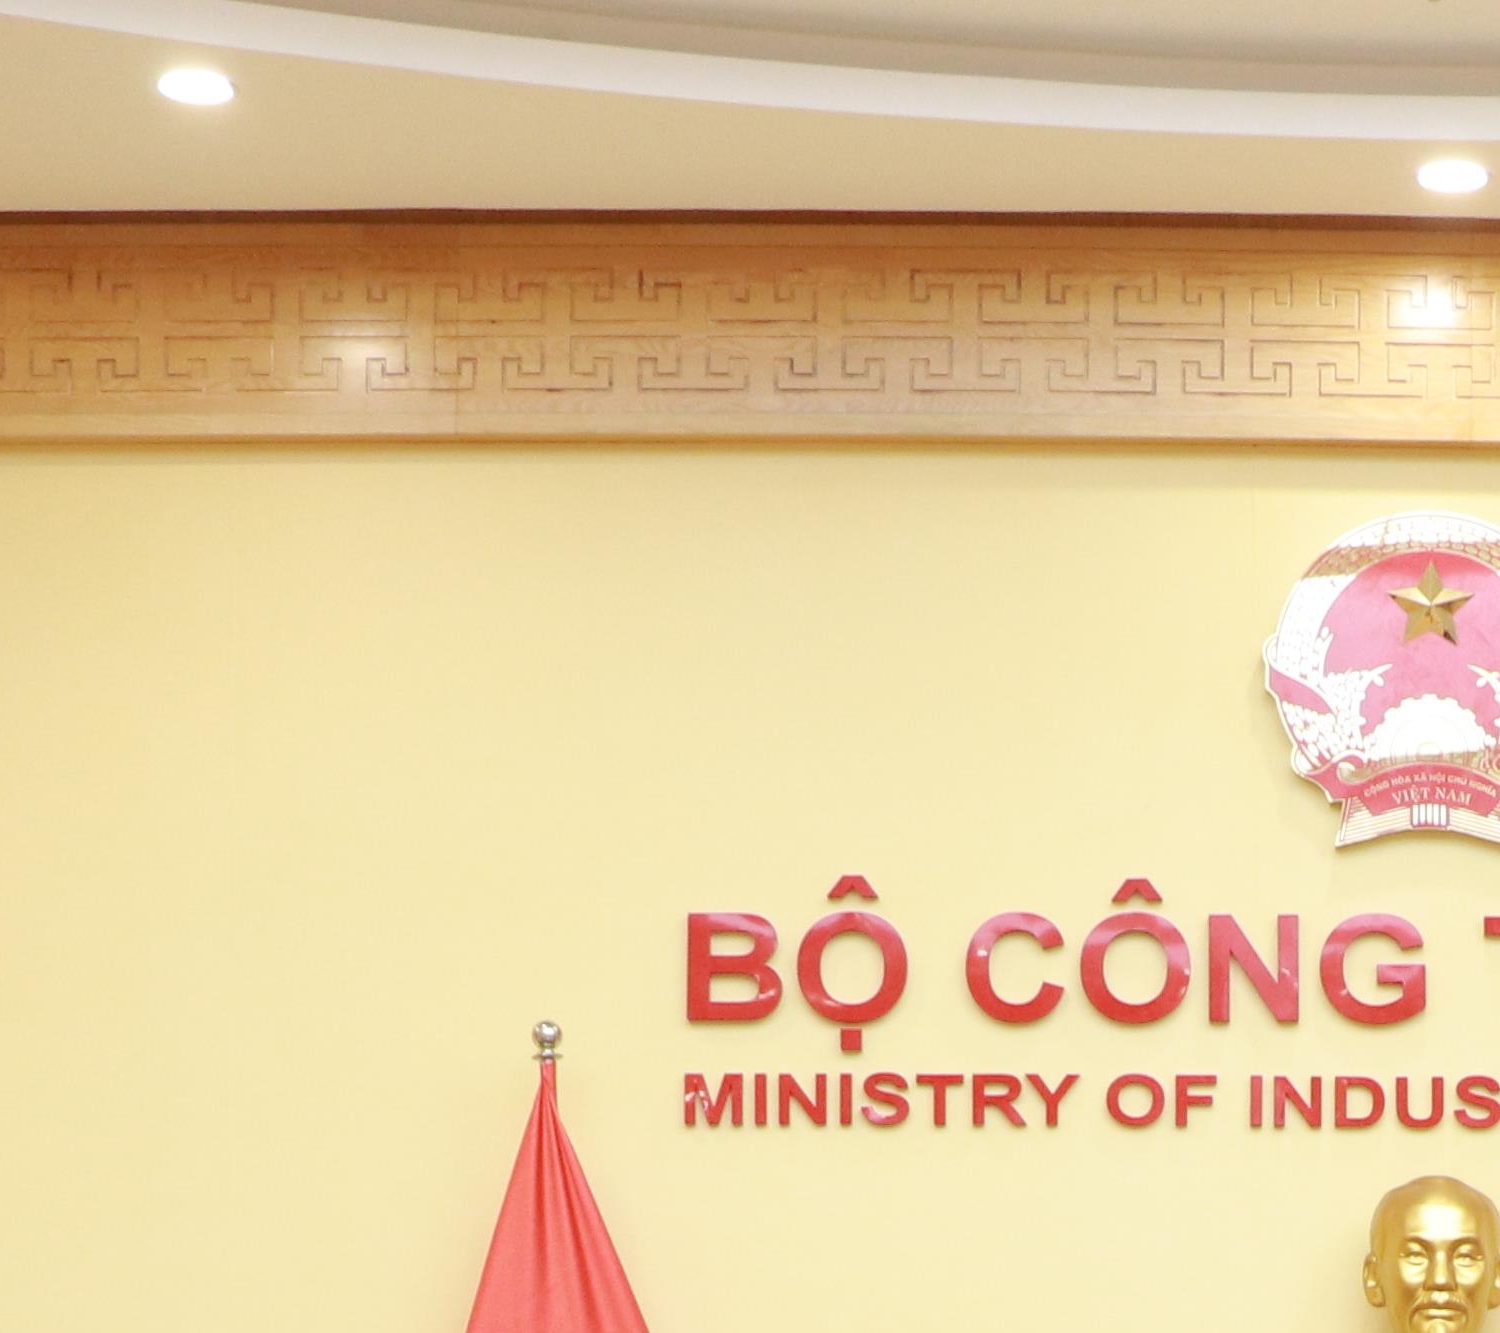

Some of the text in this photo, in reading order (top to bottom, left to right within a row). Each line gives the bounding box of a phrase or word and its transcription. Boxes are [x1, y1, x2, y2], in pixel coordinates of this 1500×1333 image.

[1391, 784, 1472, 805] VIỆT NAM
[687, 876, 907, 1051] BỘ
[967, 879, 1426, 1025] CÔNG
[684, 1072, 1077, 1125] MINISTRY
[1107, 1074, 1216, 1126] OF
